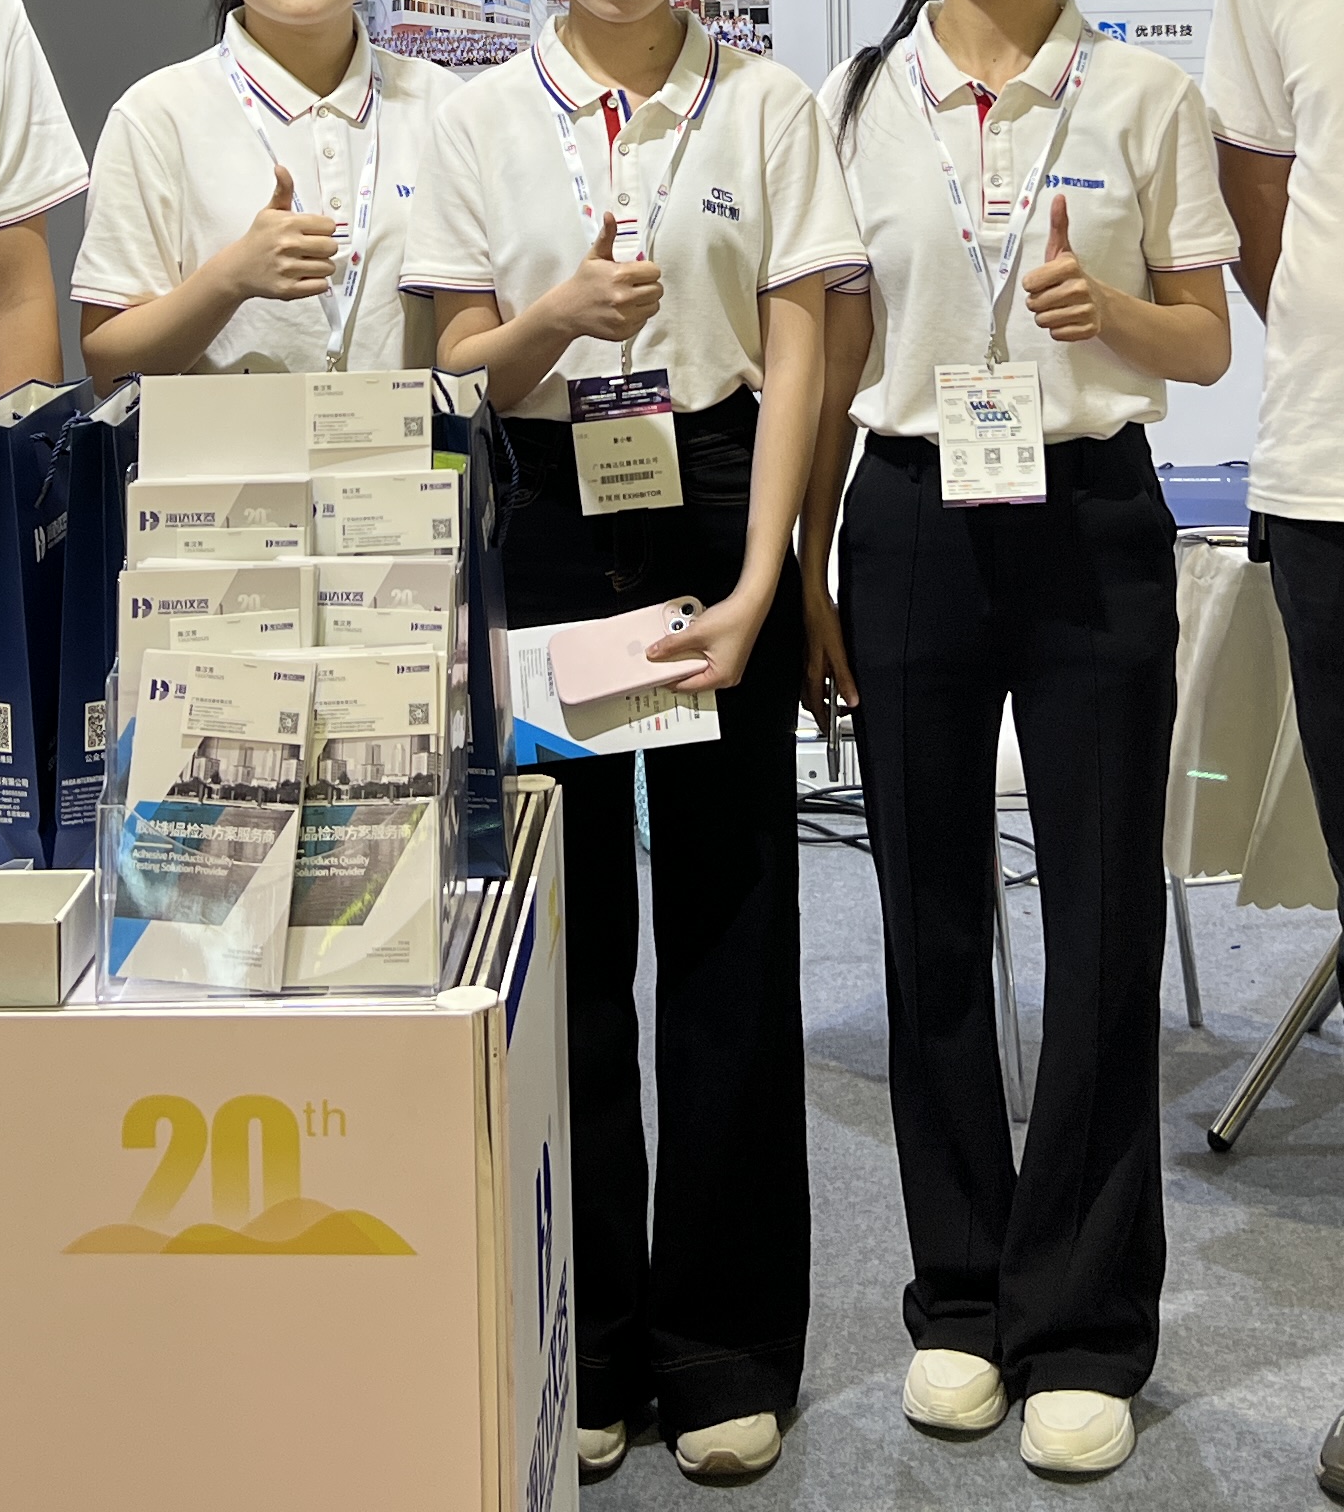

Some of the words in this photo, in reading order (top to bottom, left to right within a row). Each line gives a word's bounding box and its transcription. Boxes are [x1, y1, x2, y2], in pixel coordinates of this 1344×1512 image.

[1134, 25, 1193, 38] 优邦科技
[622, 489, 663, 501] EXHIBITOR
[132, 848, 169, 862] Adhesive
[169, 851, 204, 865] Products
[204, 854, 234, 868] Quality
[339, 854, 370, 868] Quality
[133, 860, 160, 875] Testing
[160, 862, 194, 875] Solution
[194, 864, 229, 877] Provider
[329, 866, 366, 878] Provider
